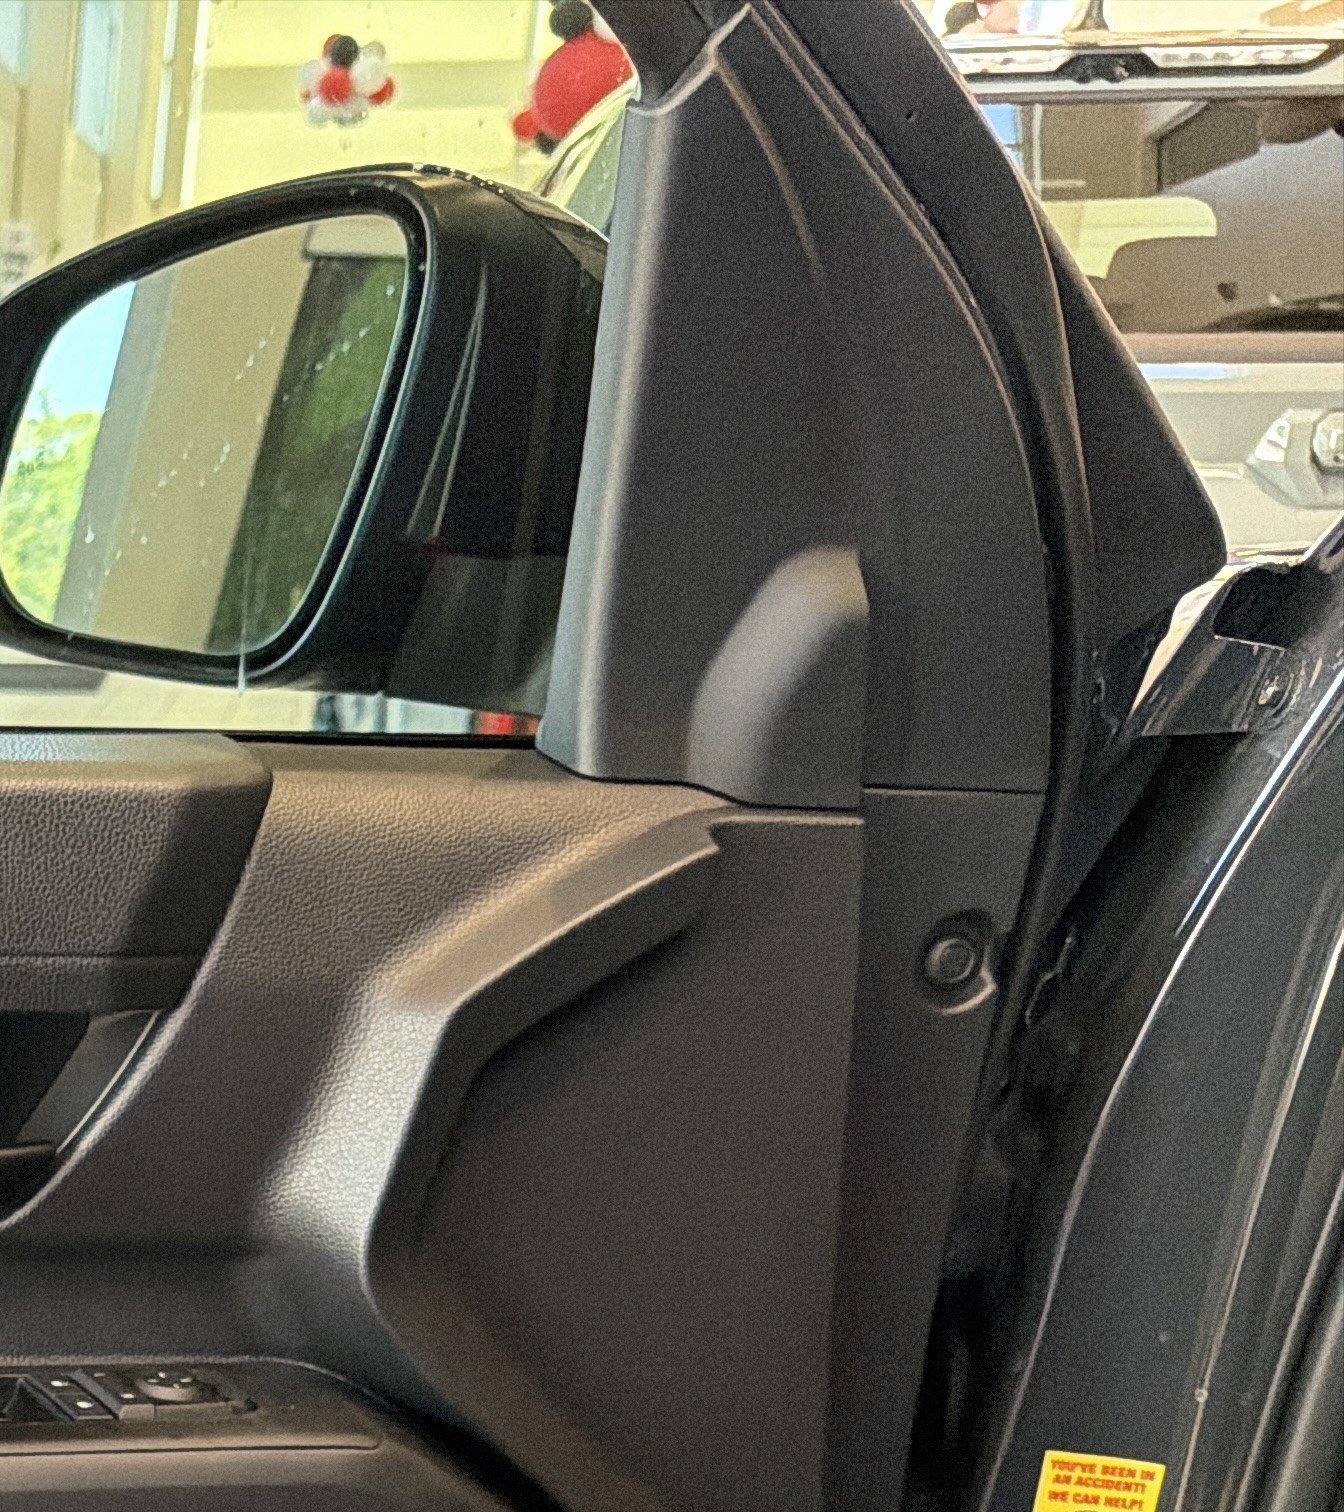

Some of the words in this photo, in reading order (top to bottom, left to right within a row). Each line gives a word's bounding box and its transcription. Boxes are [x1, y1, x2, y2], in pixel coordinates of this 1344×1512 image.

[1052, 1473, 1072, 1485] AN
[1101, 1464, 1137, 1478] BEEN
[1140, 1469, 1155, 1481] IN
[1048, 1490, 1069, 1502] WE
[1073, 1493, 1100, 1506] CAN
[1104, 1495, 1144, 1511] HELP!
